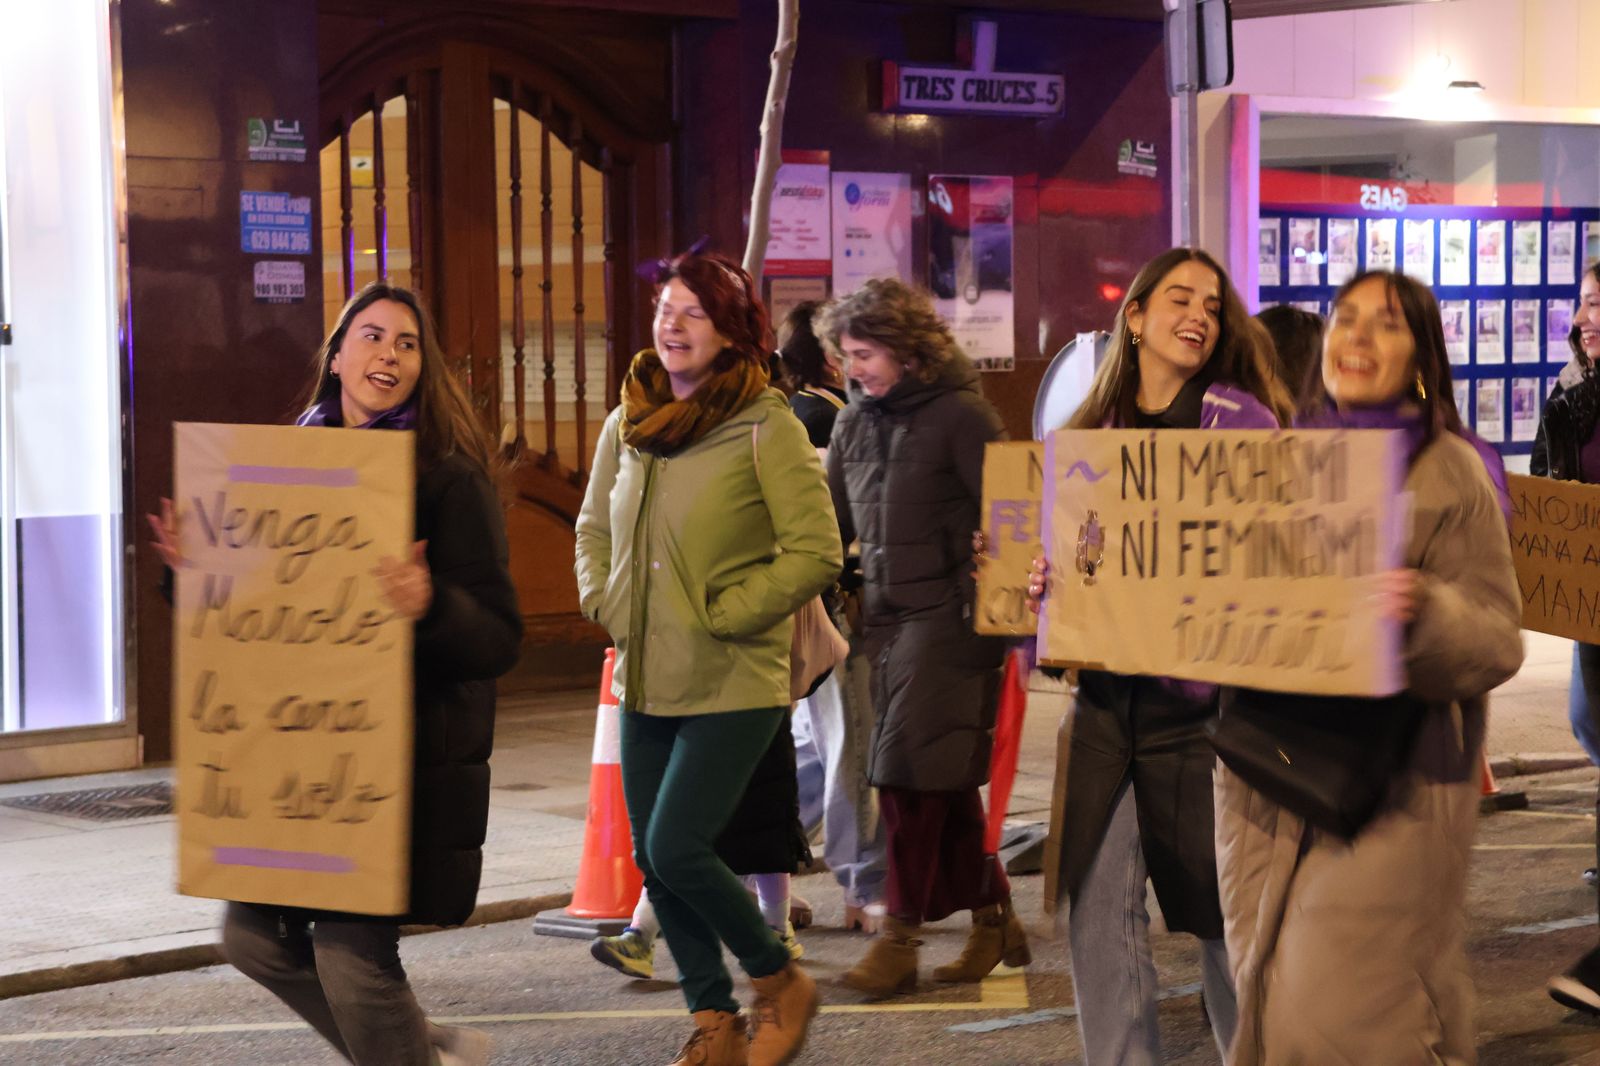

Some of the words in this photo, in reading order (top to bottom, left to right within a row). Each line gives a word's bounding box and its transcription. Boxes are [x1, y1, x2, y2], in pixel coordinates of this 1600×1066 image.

[904, 75, 954, 101] TRES
[192, 491, 373, 585] Venga
[189, 670, 248, 735] la
